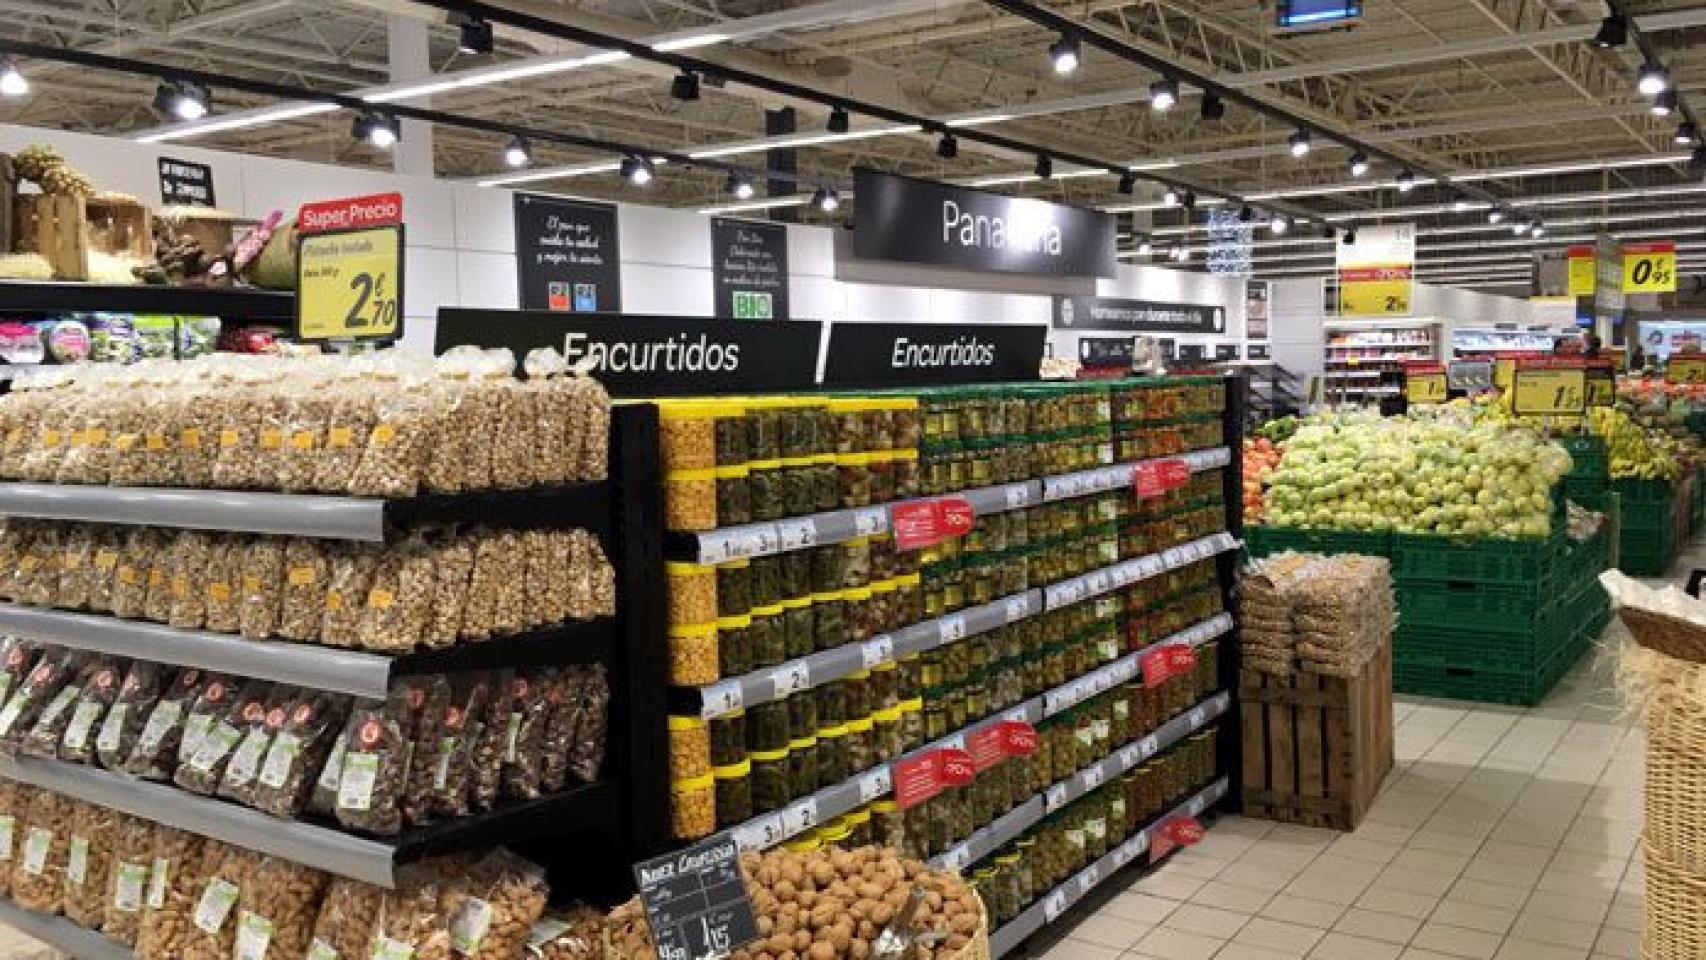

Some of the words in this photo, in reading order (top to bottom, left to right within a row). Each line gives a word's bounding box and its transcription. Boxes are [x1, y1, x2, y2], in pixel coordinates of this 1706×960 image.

[303, 209, 348, 229] Super
[350, 203, 398, 219] Precio
[943, 200, 1061, 256] Panaa
[1632, 259, 1652, 285] 0
[344, 272, 373, 329] 2
[372, 298, 395, 327] 70
[737, 295, 769, 317] BIO
[564, 332, 741, 373] Encurtidos
[892, 335, 996, 368] Encurtidos
